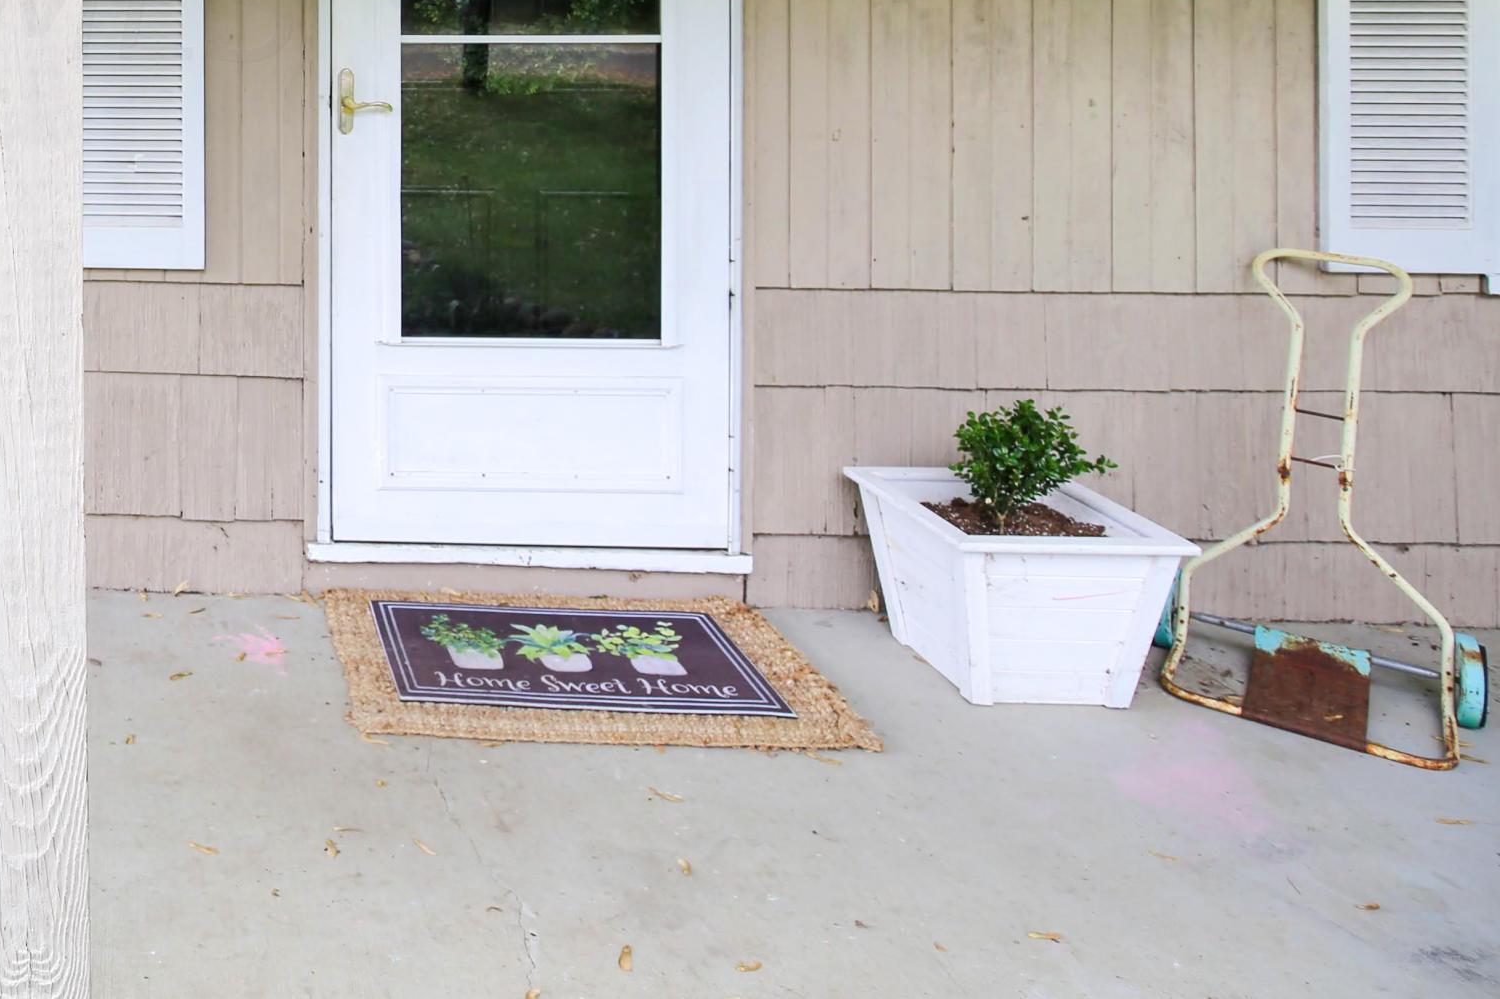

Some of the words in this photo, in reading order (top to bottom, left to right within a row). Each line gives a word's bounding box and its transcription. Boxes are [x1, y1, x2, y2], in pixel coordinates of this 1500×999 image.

[434, 671, 532, 692] Home
[540, 674, 632, 694] Sweet
[637, 677, 739, 698] Home
